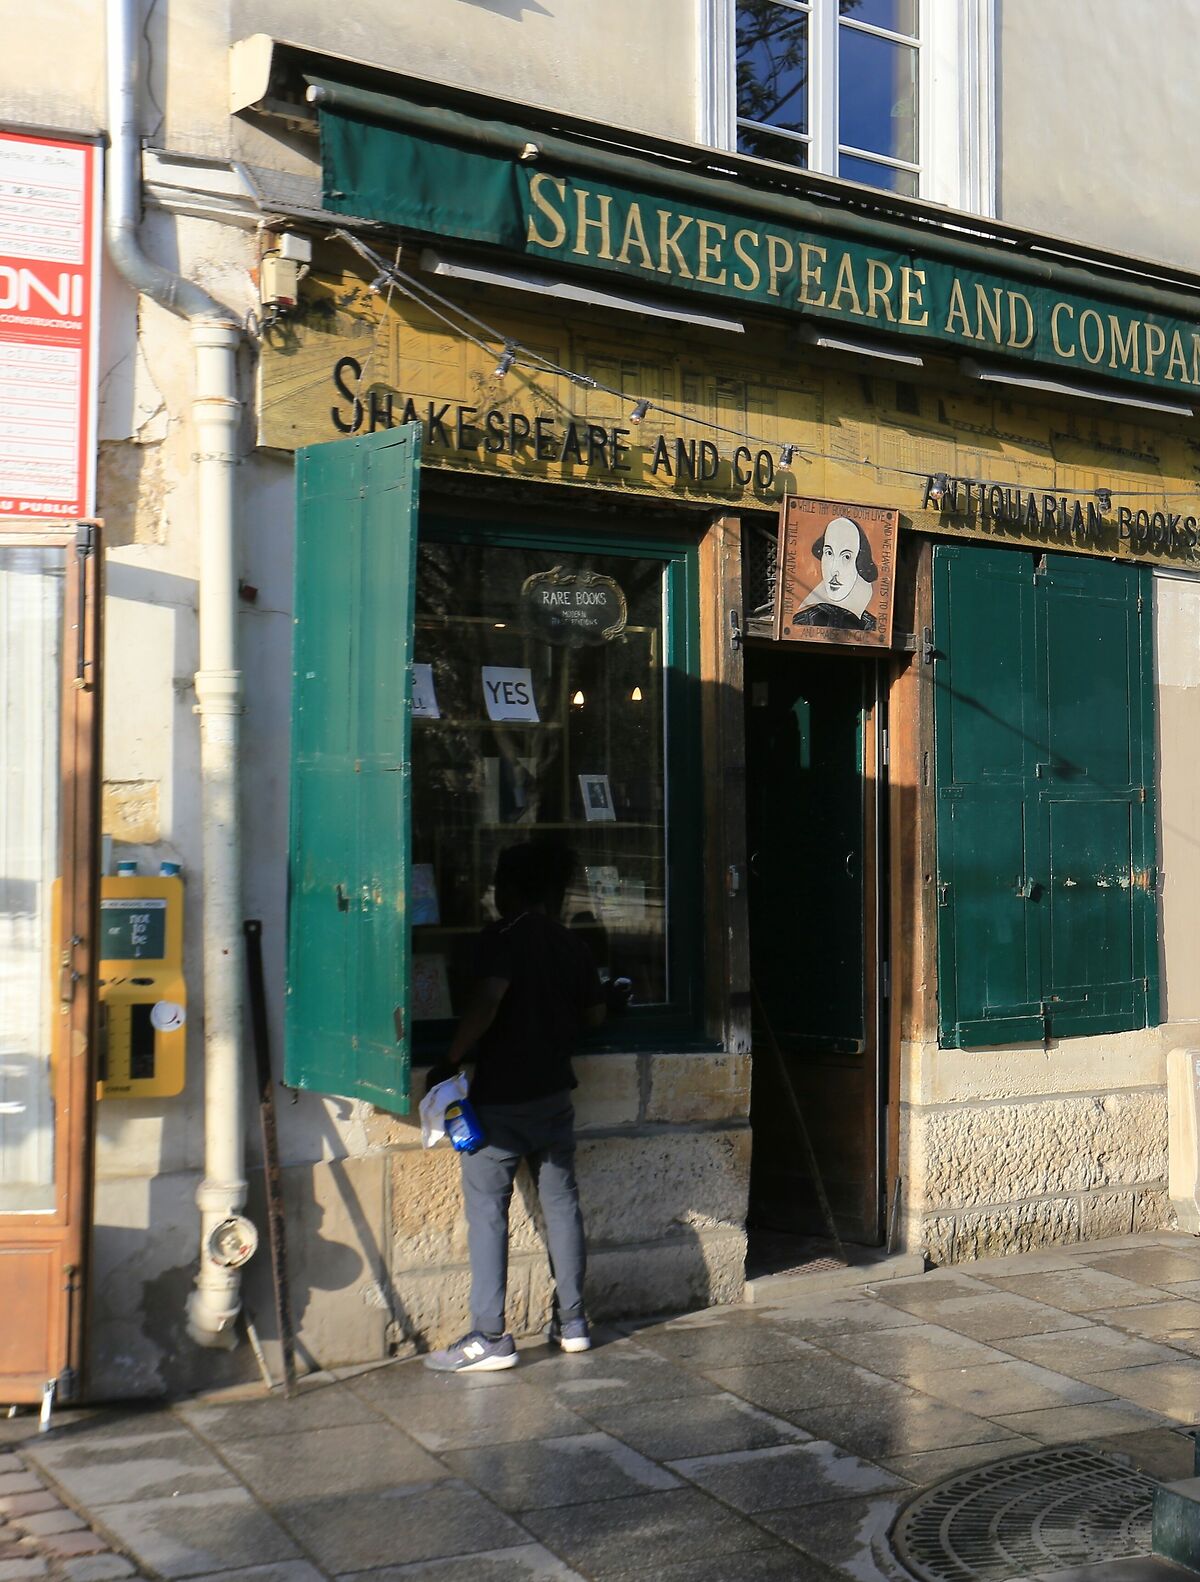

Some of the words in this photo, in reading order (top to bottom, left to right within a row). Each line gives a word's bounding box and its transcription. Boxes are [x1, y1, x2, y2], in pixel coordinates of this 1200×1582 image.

[527, 172, 929, 327] SHAKESPEARE
[944, 278, 1034, 349] AND
[332, 356, 631, 471] SHAKESPEARE
[652, 434, 720, 481] AND
[731, 446, 774, 489] CO
[19, 502, 79, 515] PUBLIC
[871, 510, 885, 522] LIVE
[922, 476, 1102, 538] ANTIQUARIAN
[1118, 505, 1198, 548] BOOKS
[787, 521, 798, 546] STILL
[786, 549, 797, 575] ALIVE
[881, 551, 891, 572] HAVE
[880, 576, 890, 597] WITS
[542, 591, 571, 605] RARE
[576, 591, 607, 605] BOOKS
[879, 600, 888, 610] TO
[878, 612, 888, 634] READ
[486, 681, 530, 706] YES
